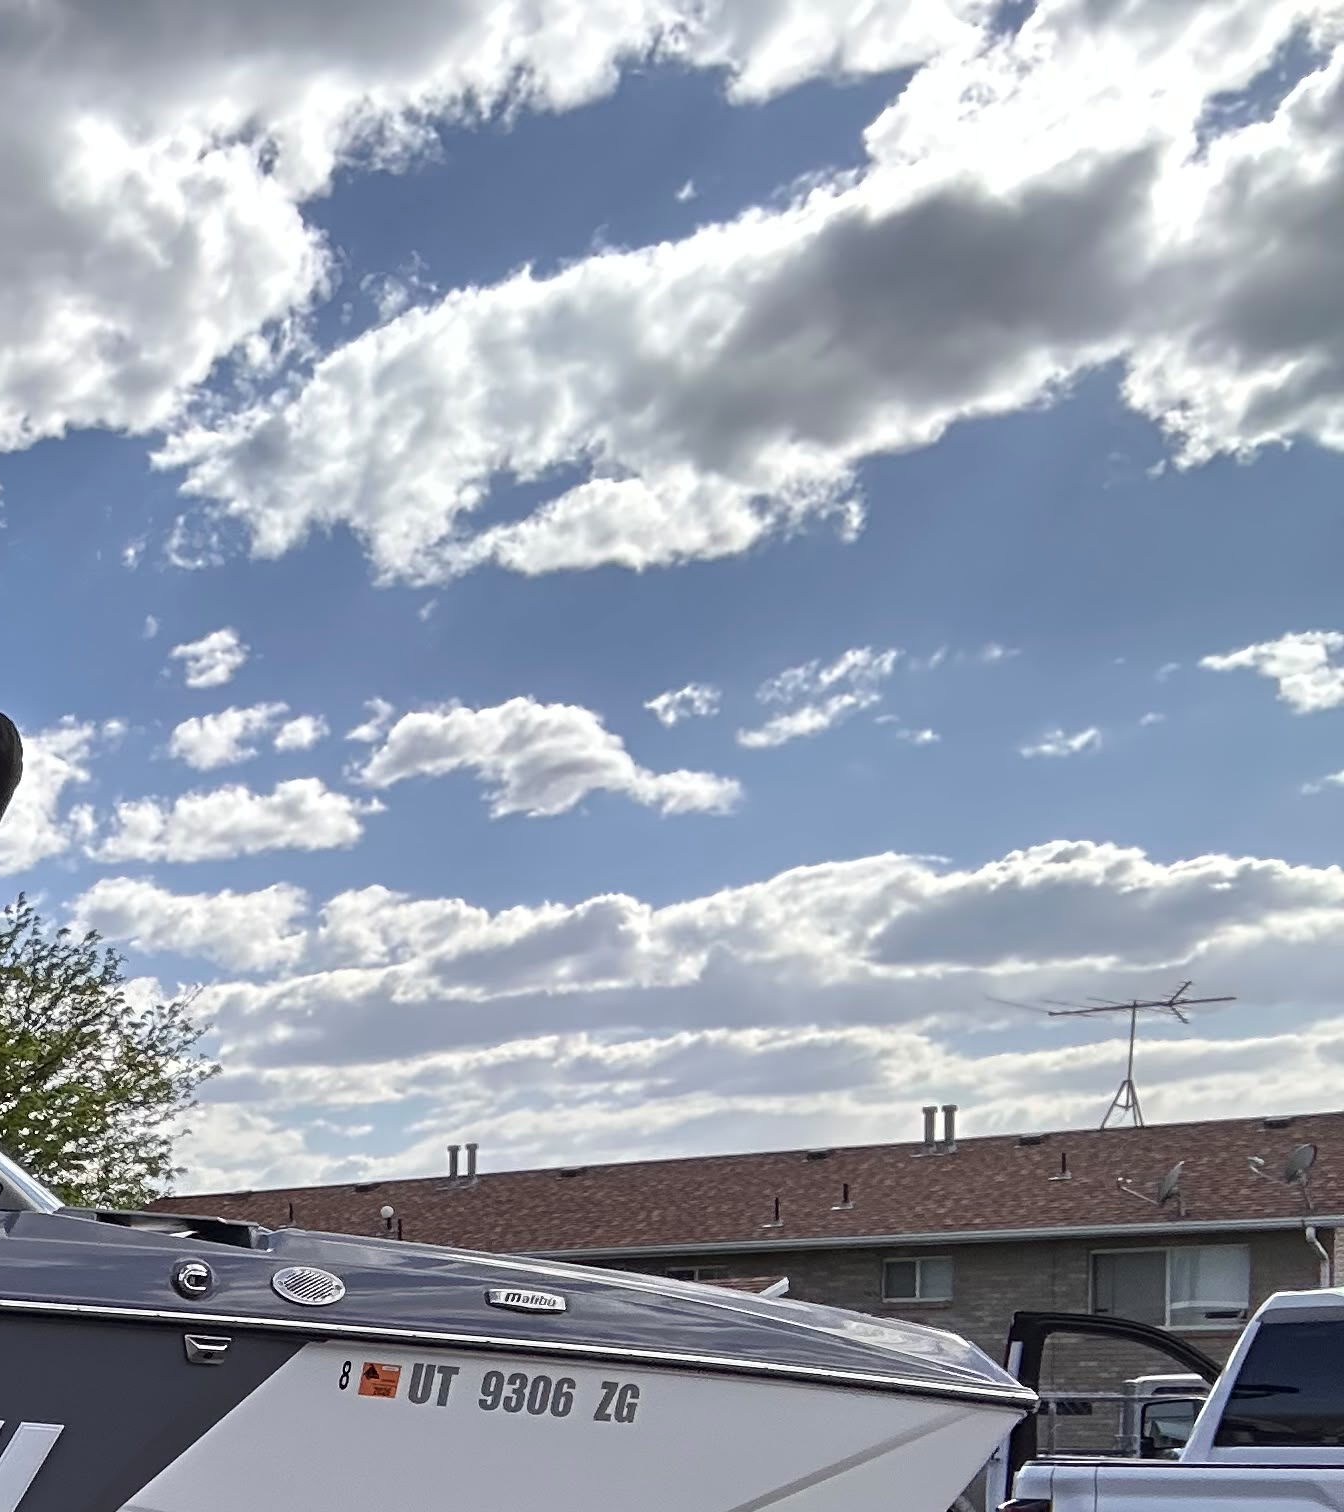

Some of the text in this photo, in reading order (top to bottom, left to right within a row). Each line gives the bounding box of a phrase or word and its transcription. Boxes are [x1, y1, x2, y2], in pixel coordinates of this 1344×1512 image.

[338, 1360, 352, 1391] 8
[407, 1362, 641, 1424] UT 9306 ZG
